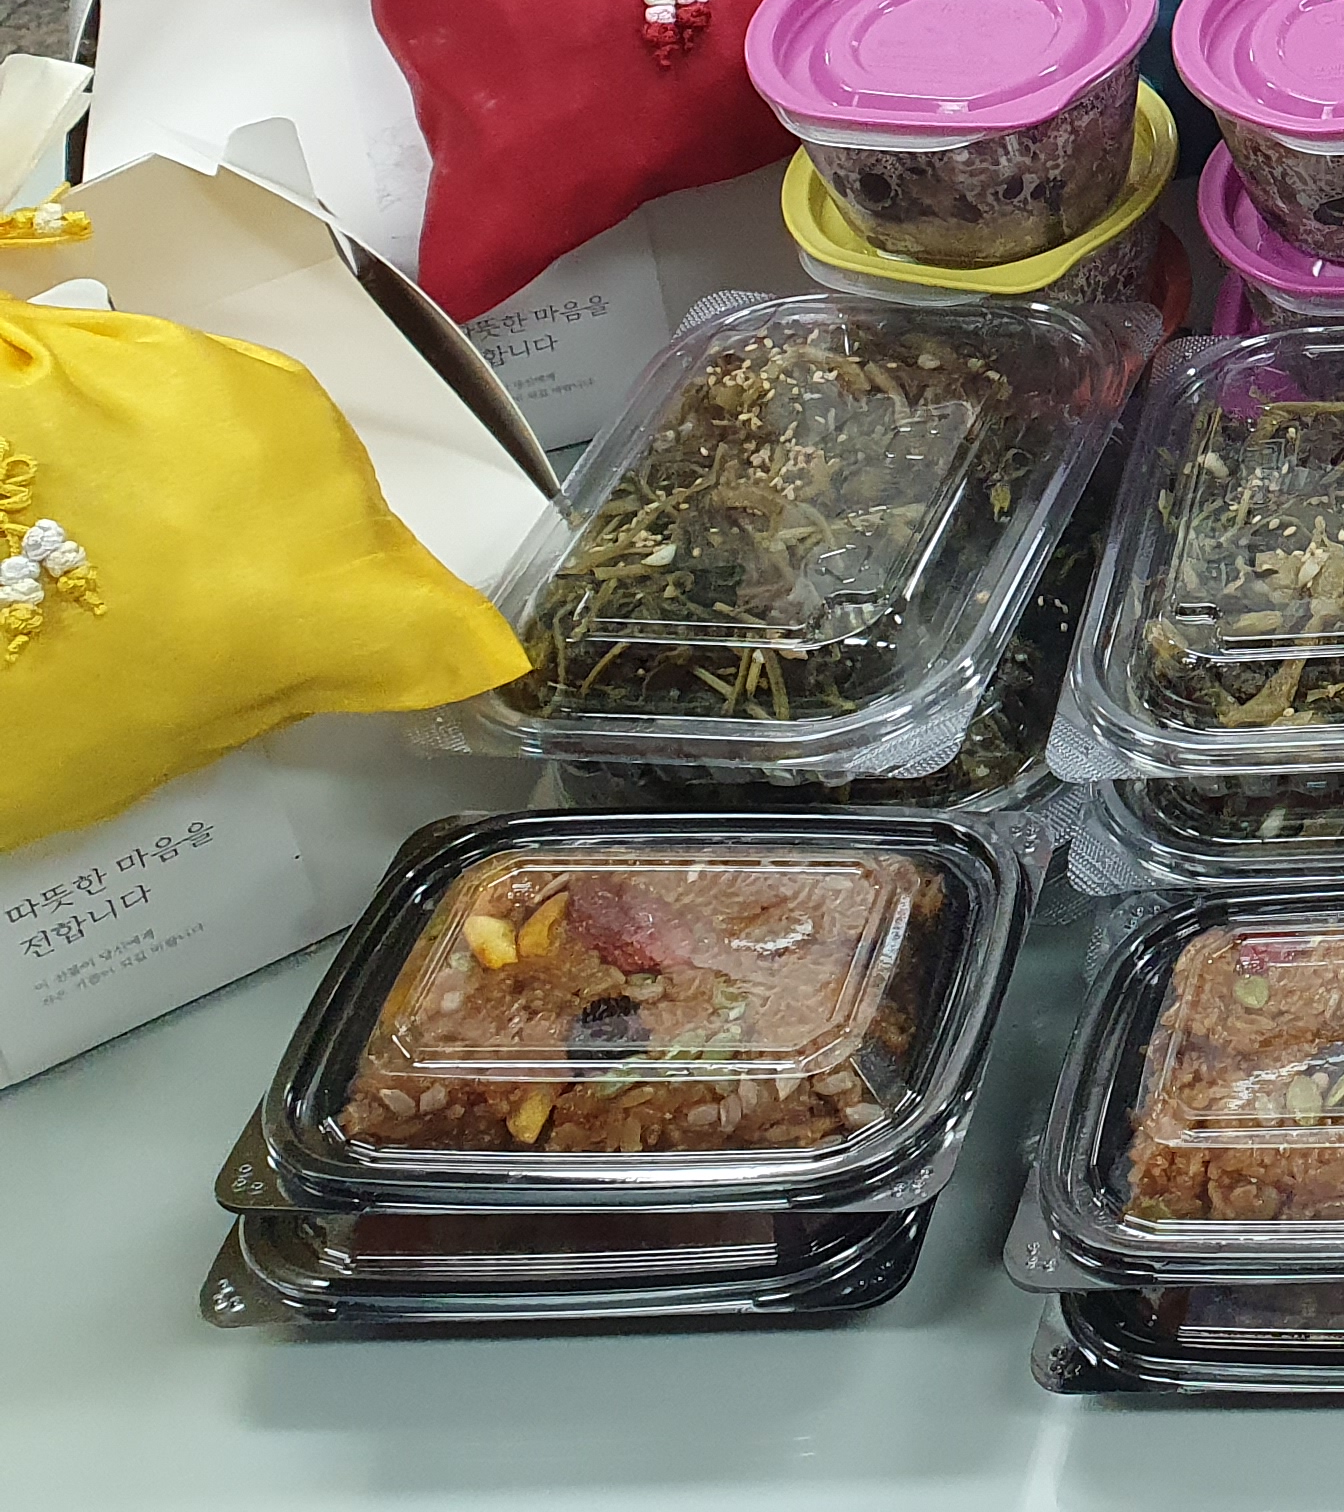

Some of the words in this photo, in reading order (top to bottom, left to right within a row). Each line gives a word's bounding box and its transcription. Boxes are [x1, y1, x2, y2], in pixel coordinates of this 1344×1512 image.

[533, 295, 609, 323] 마음을
[483, 334, 559, 368] 합니다
[5, 868, 107, 923] 따뜻한
[116, 822, 214, 872] 마음을
[20, 884, 152, 958] 전합니다
